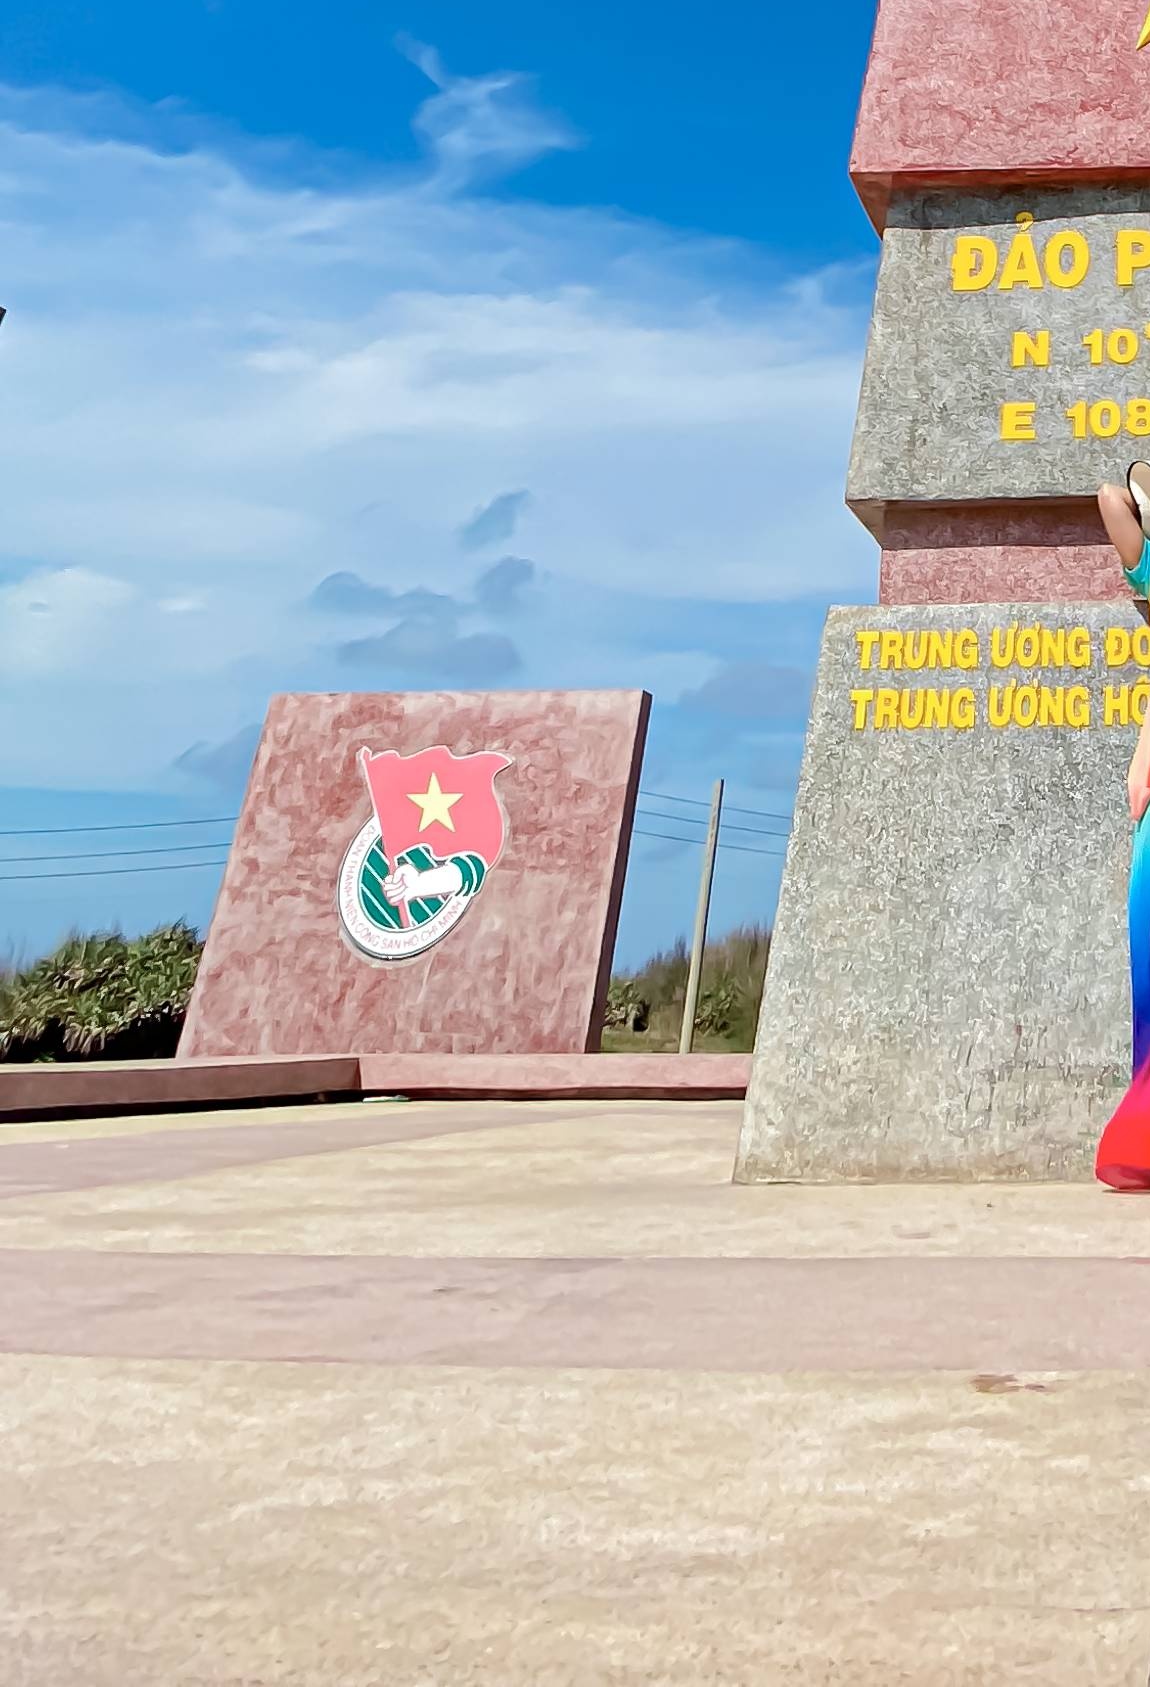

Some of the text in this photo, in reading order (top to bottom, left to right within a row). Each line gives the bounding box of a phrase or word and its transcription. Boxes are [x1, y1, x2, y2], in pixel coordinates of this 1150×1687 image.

[951, 211, 1091, 291] ĐẢO
[1011, 330, 1051, 367] N
[1000, 402, 1036, 440] E
[855, 629, 979, 670] TRUNG
[990, 620, 1092, 669] ƯƠNG
[851, 688, 976, 730] TRUNG
[988, 678, 1091, 729] ƯƠNG
